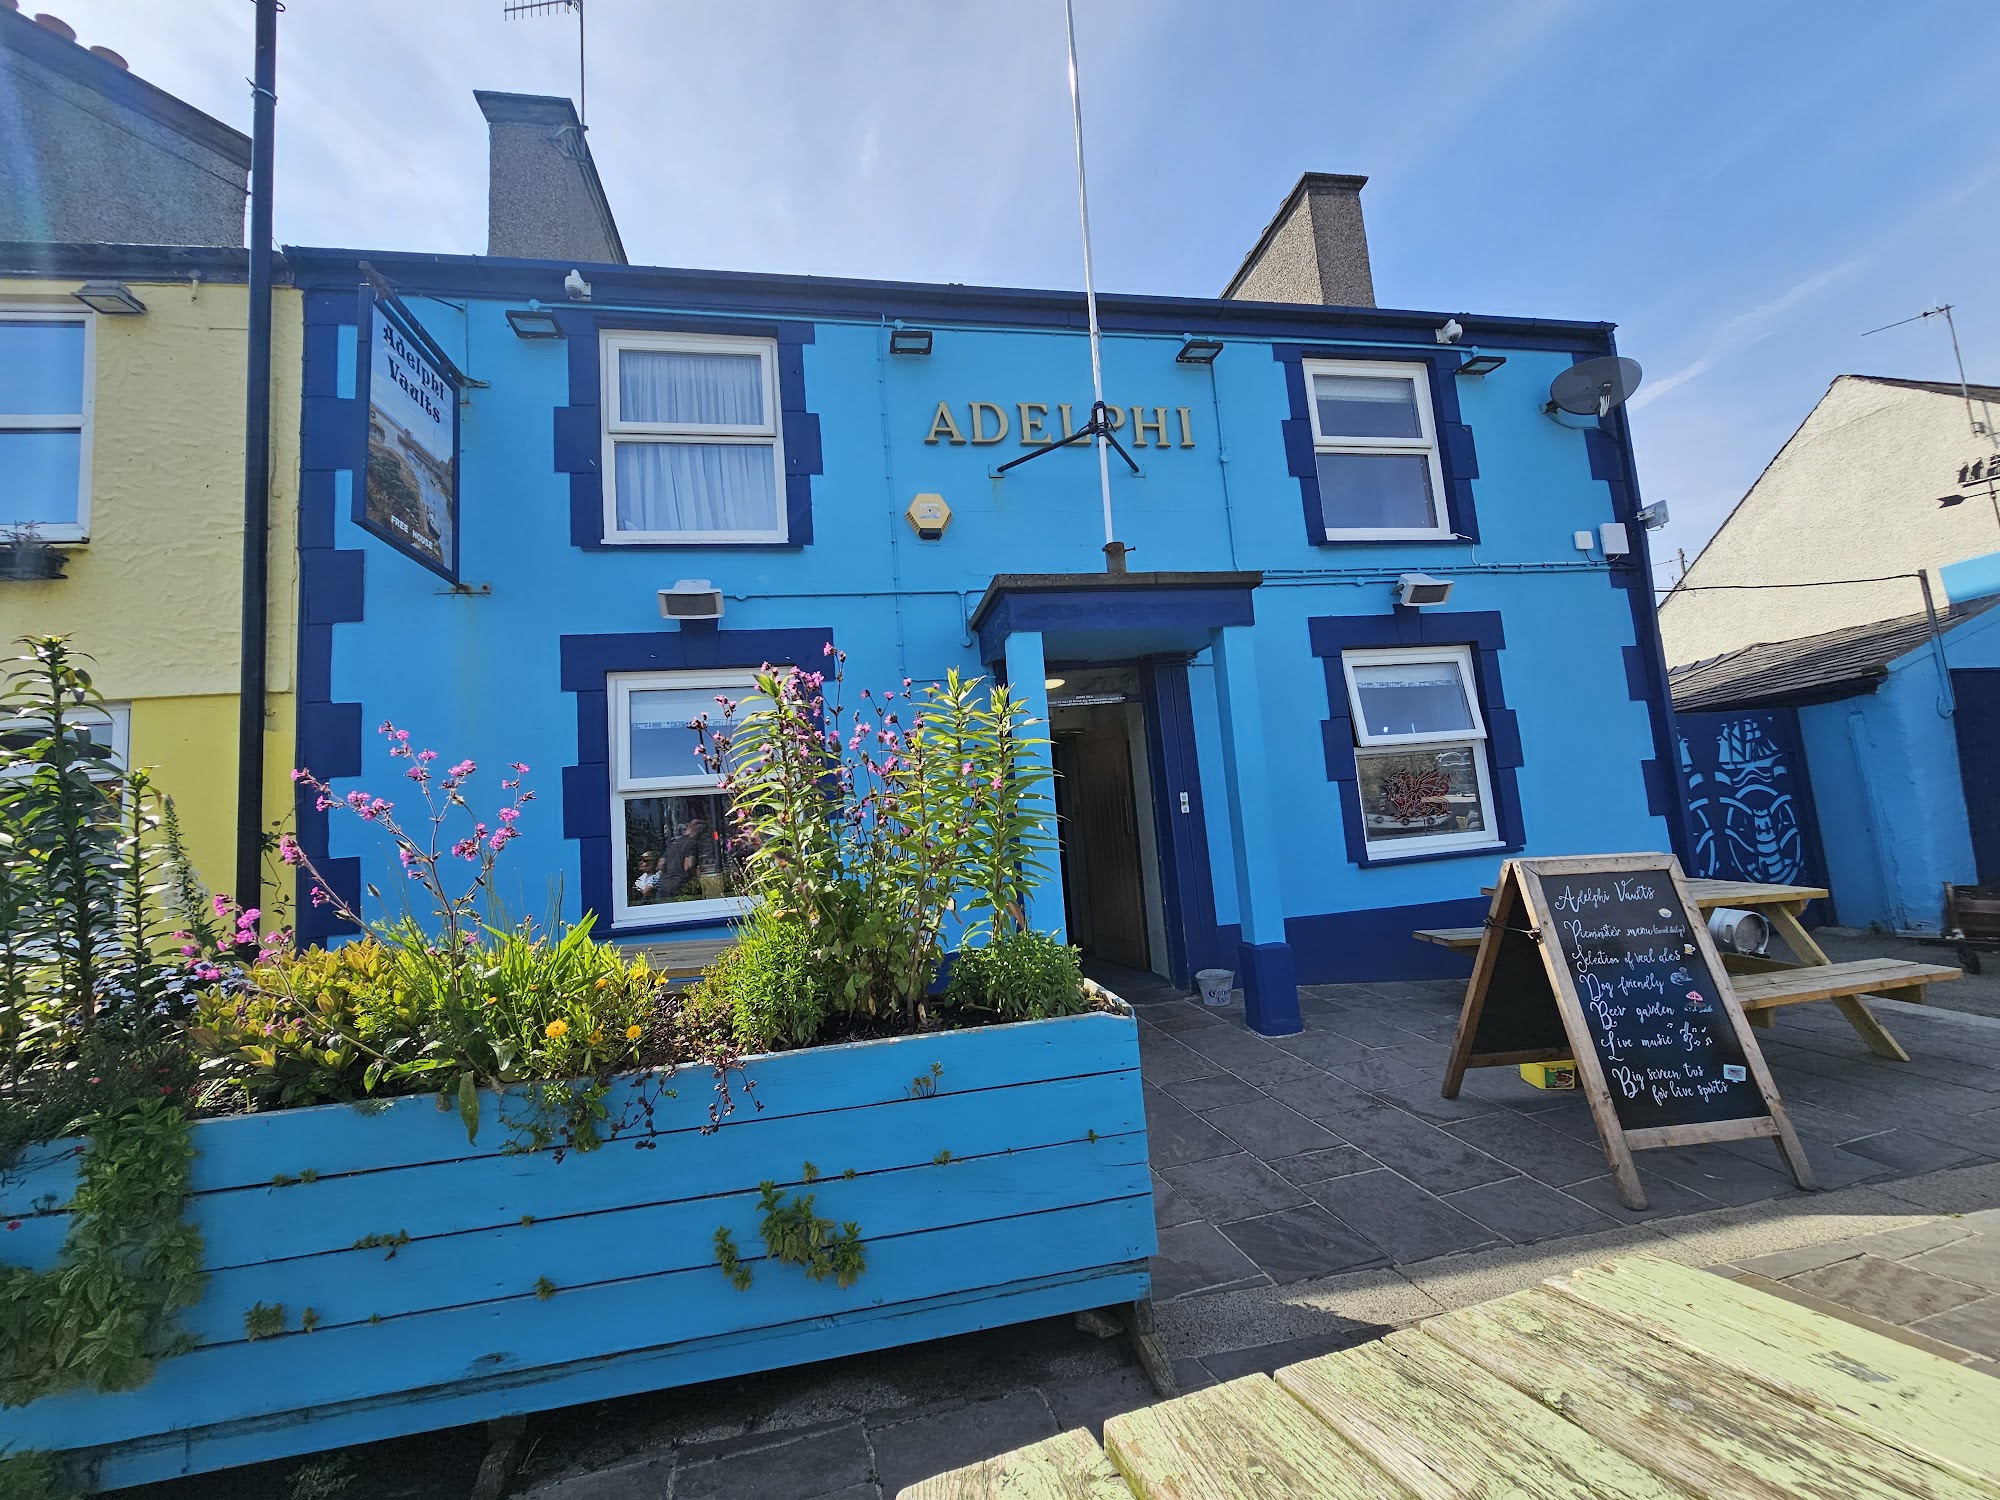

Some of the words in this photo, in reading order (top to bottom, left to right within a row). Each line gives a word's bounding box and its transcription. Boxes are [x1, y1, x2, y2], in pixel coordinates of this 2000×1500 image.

[383, 323, 445, 401] Adelphi
[387, 355, 441, 424] Vaults
[924, 400, 1196, 448] ADELPHI
[390, 514, 409, 534] FREE
[412, 529, 433, 550] HOUSE
[1554, 885, 1610, 913] Adelphi
[1614, 877, 1655, 902] Vaults
[1626, 927, 1653, 937] menu
[1571, 944, 1620, 973] Selection
[1624, 951, 1634, 970] of
[1634, 947, 1656, 964] real
[1658, 947, 1681, 962] ales
[1578, 972, 1614, 1002] Dog
[1617, 972, 1664, 996] friendly
[1589, 1000, 1627, 1030] Beer
[1635, 1001, 1675, 1024] garden
[1600, 1030, 1634, 1061] Live
[1641, 1033, 1673, 1048] music
[1611, 1065, 1645, 1099] Big
[1646, 1067, 1681, 1081] screen
[1652, 1084, 1669, 1107] for
[1669, 1081, 1694, 1098] live
[1697, 1078, 1728, 1103] sports
